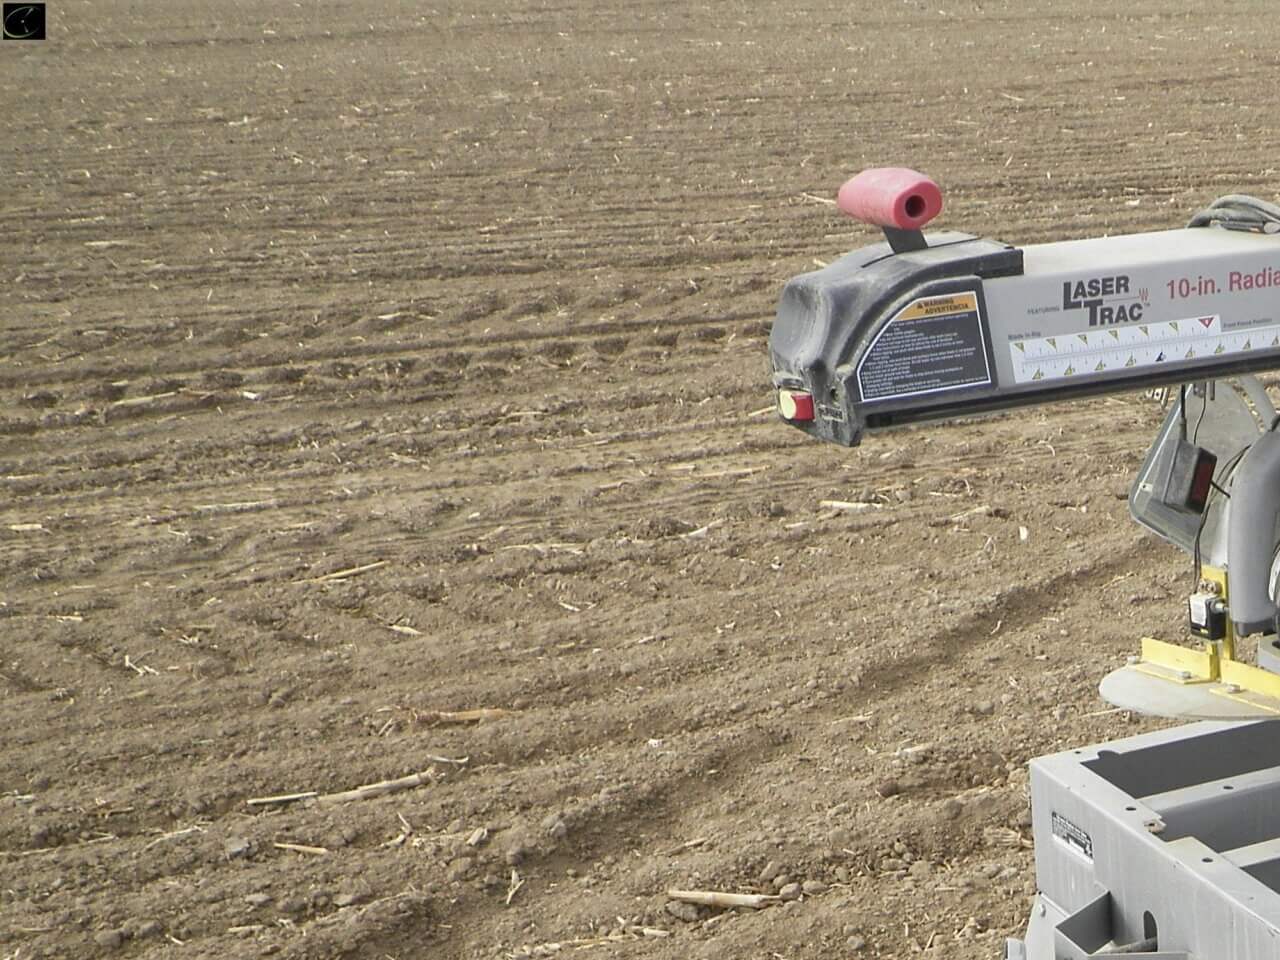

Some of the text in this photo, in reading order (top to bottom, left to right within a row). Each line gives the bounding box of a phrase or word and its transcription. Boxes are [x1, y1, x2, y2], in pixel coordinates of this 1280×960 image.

[1063, 275, 1130, 311] LASER
[1167, 276, 1221, 300] 10-in.
[1083, 299, 1143, 327] TRAC
